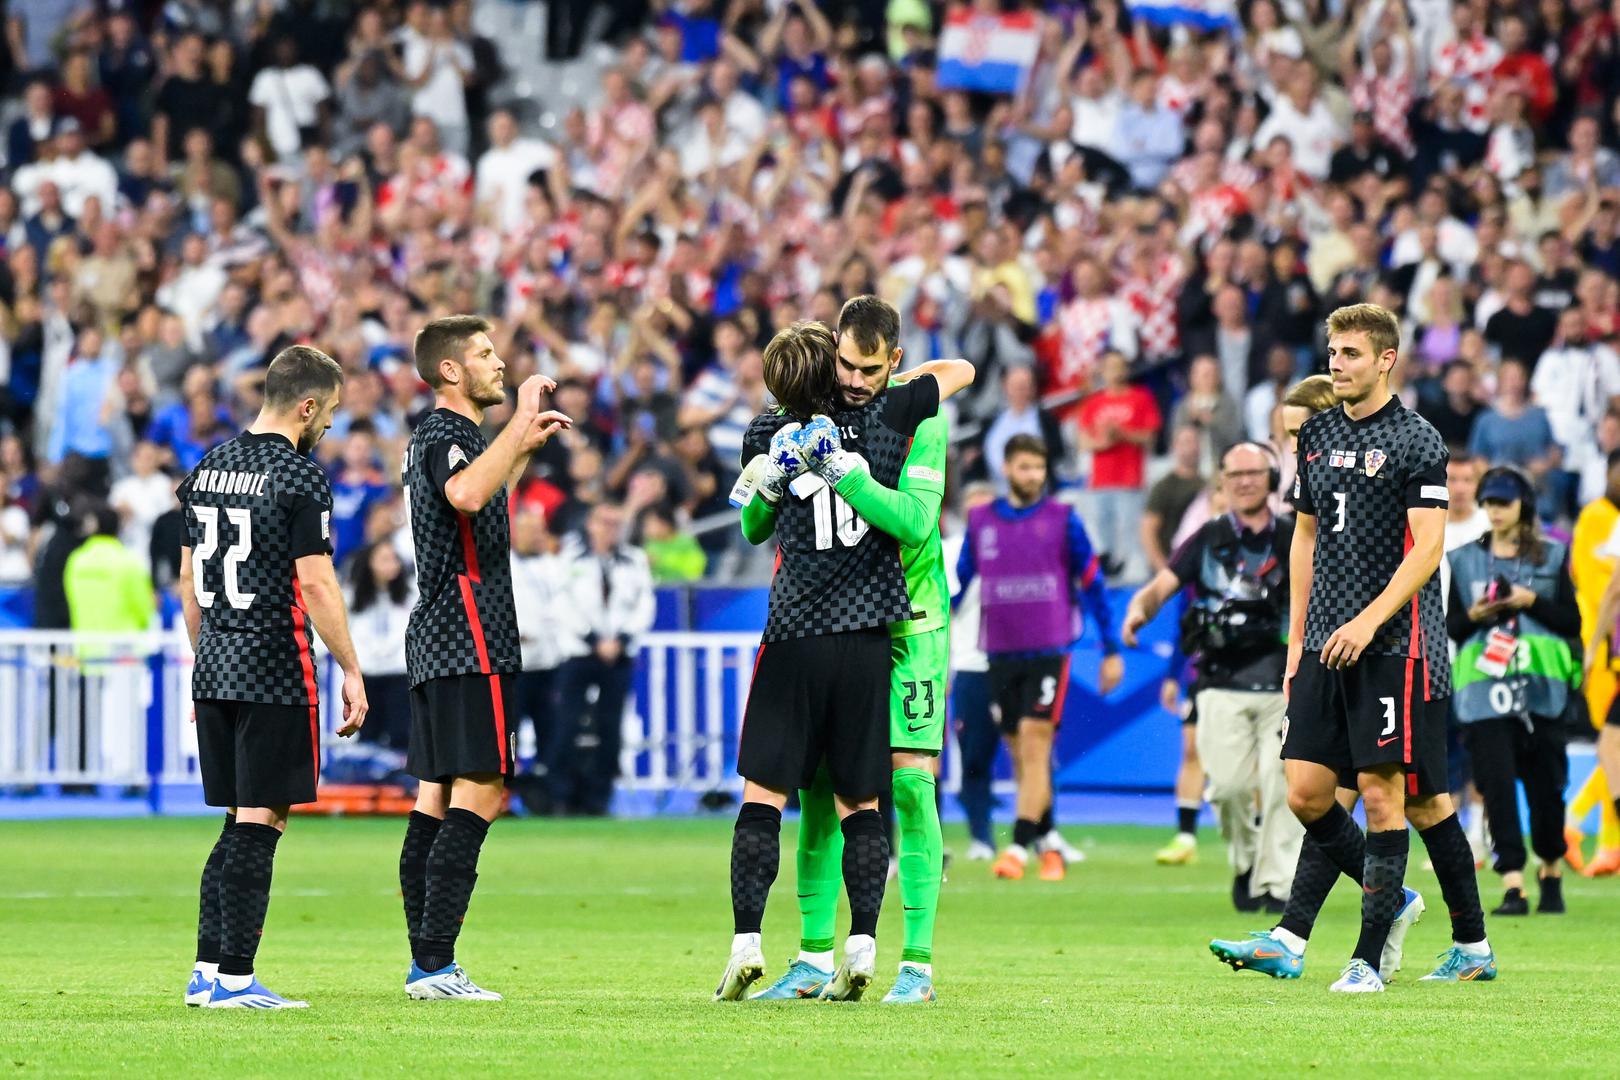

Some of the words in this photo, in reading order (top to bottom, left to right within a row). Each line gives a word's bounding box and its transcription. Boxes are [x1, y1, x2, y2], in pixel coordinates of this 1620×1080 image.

[811, 452, 871, 551] 10
[1332, 491, 1346, 532] 3
[191, 505, 257, 610] 22
[901, 680, 934, 720] 23
[1378, 696, 1396, 736] 3
